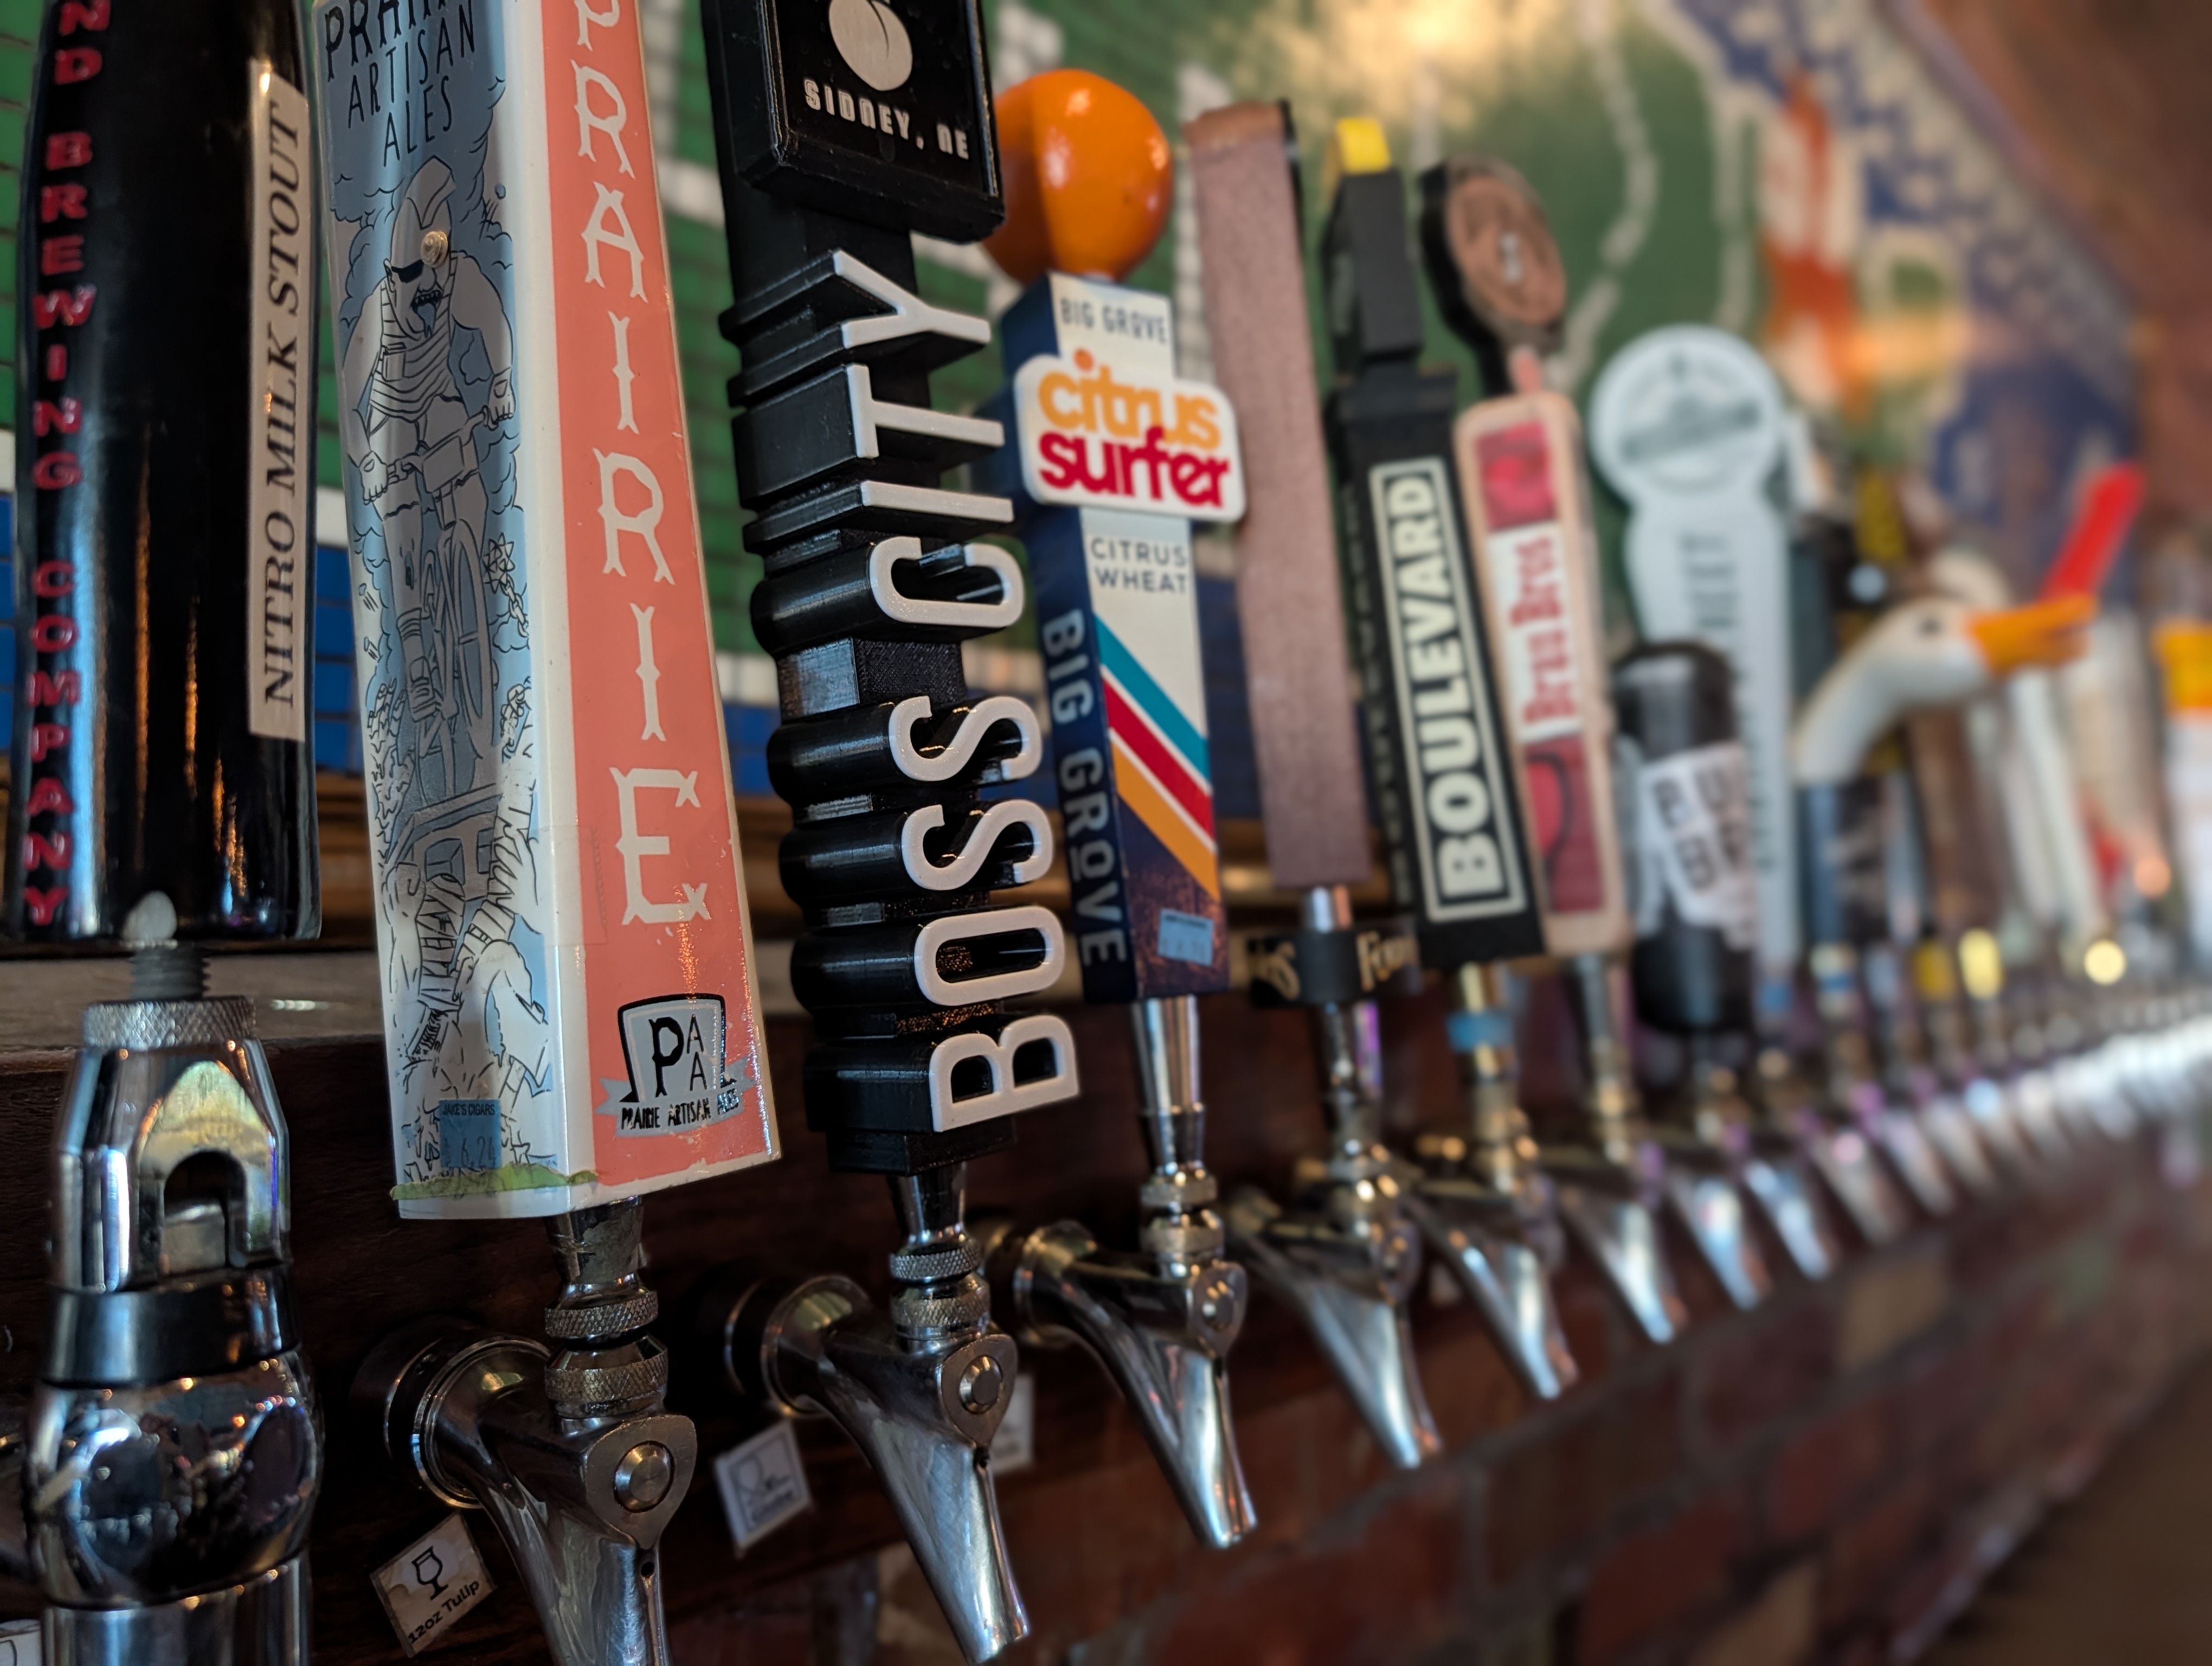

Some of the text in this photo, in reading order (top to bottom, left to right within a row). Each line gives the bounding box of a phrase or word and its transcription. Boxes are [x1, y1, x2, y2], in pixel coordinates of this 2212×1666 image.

[348, 0, 475, 129] ARTISAN
[383, 75, 452, 167] ALES
[33, 131, 97, 490] BREWING
[1060, 298, 1169, 344] BIG GROVE
[265, 102, 301, 708] NITRO MILK STOUT
[1038, 348, 1222, 452] citrus
[1038, 425, 1231, 509] surfer
[1090, 537, 1188, 567] CITRUS
[1094, 567, 1188, 593] WHEAT
[833, 249, 1079, 1132] BOSS CITY
[1386, 475, 1505, 899] BOULEVARD
[23, 561, 81, 926] COMPANY
[1042, 609, 1128, 967] BIG GROVE
[442, 1103, 496, 1116] JAKE'S CIGARS
[621, 1106, 661, 1130] PRAIRIE
[667, 1097, 711, 1126] ARTISAN
[441, 1580, 480, 1612] Tulip
